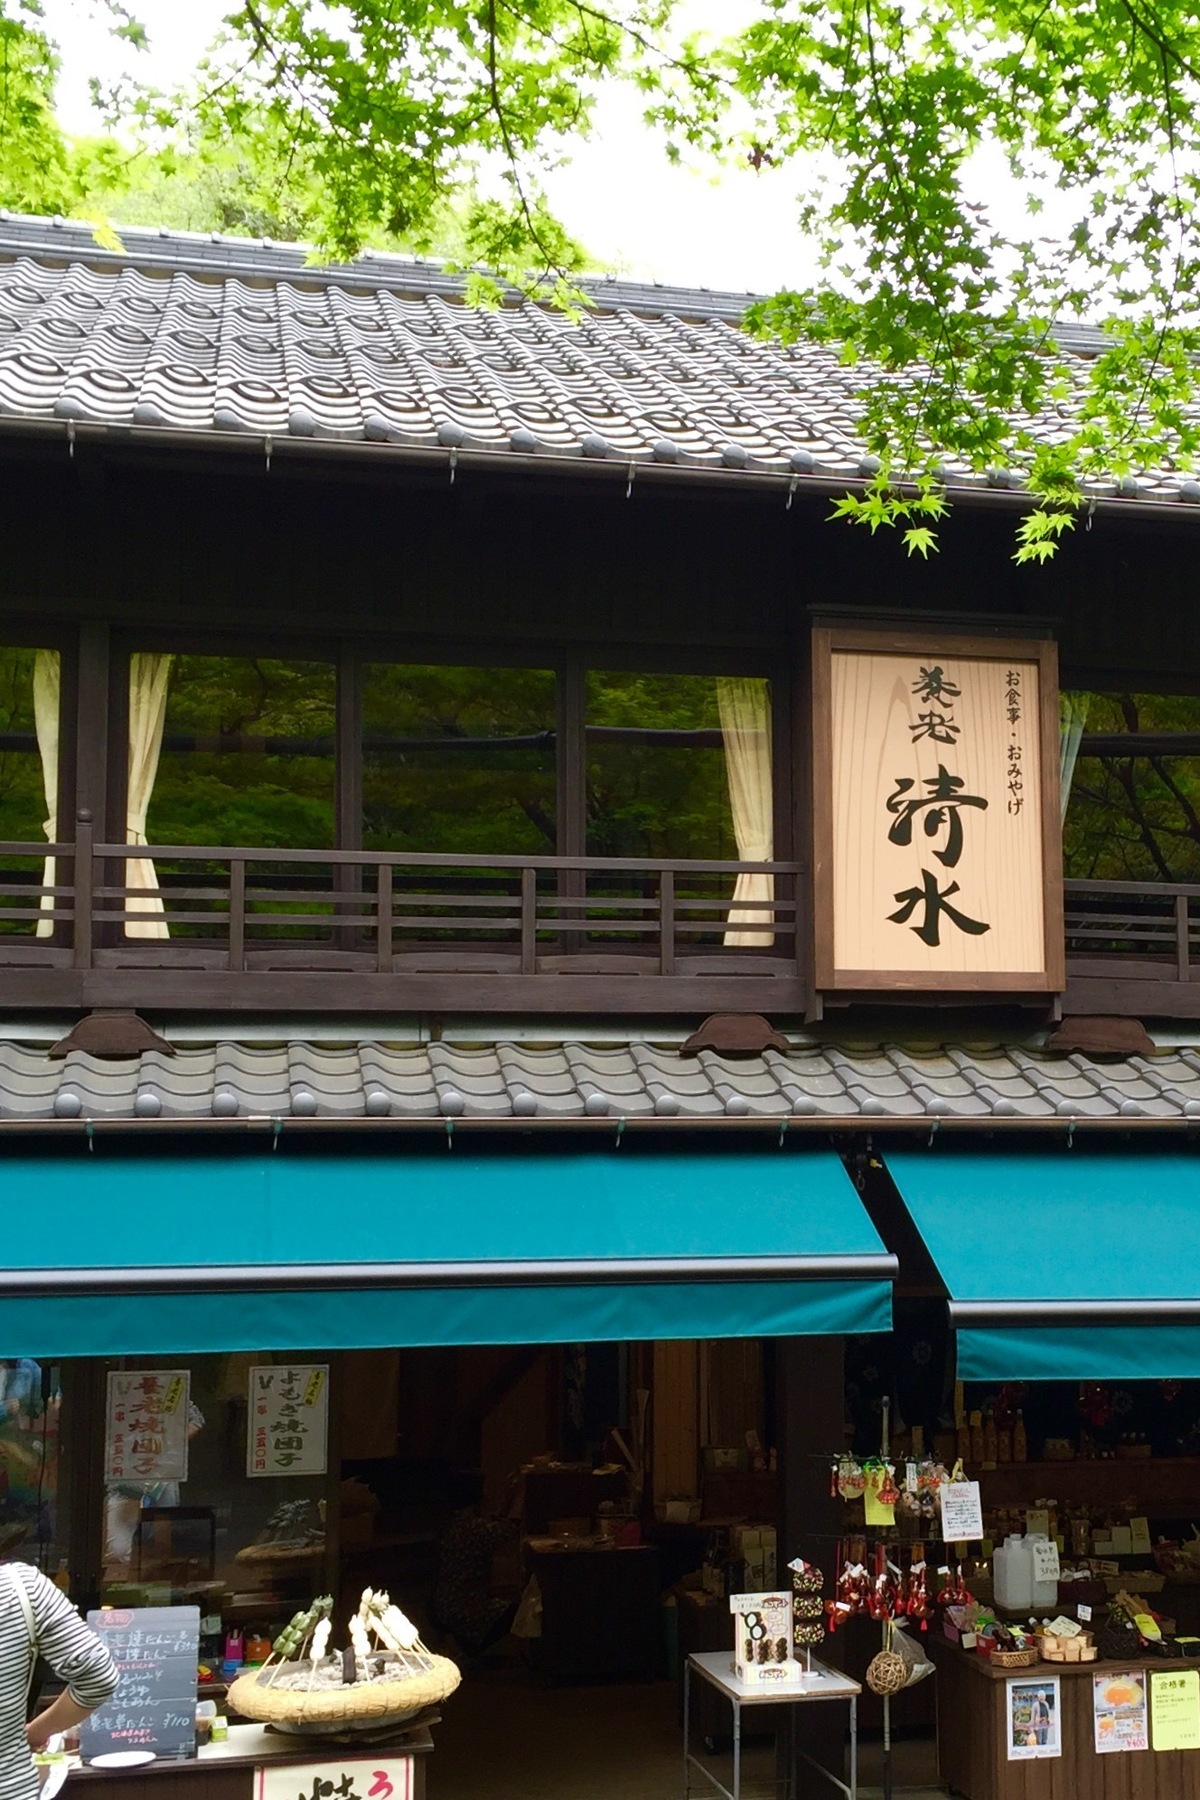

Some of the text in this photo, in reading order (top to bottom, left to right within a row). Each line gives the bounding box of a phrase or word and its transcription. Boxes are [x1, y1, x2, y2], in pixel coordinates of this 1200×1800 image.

[1005, 670, 1023, 816] お食事・おみやげ
[885, 764, 991, 947] 清水
[270, 1370, 308, 1467] よもぎ焼団子
